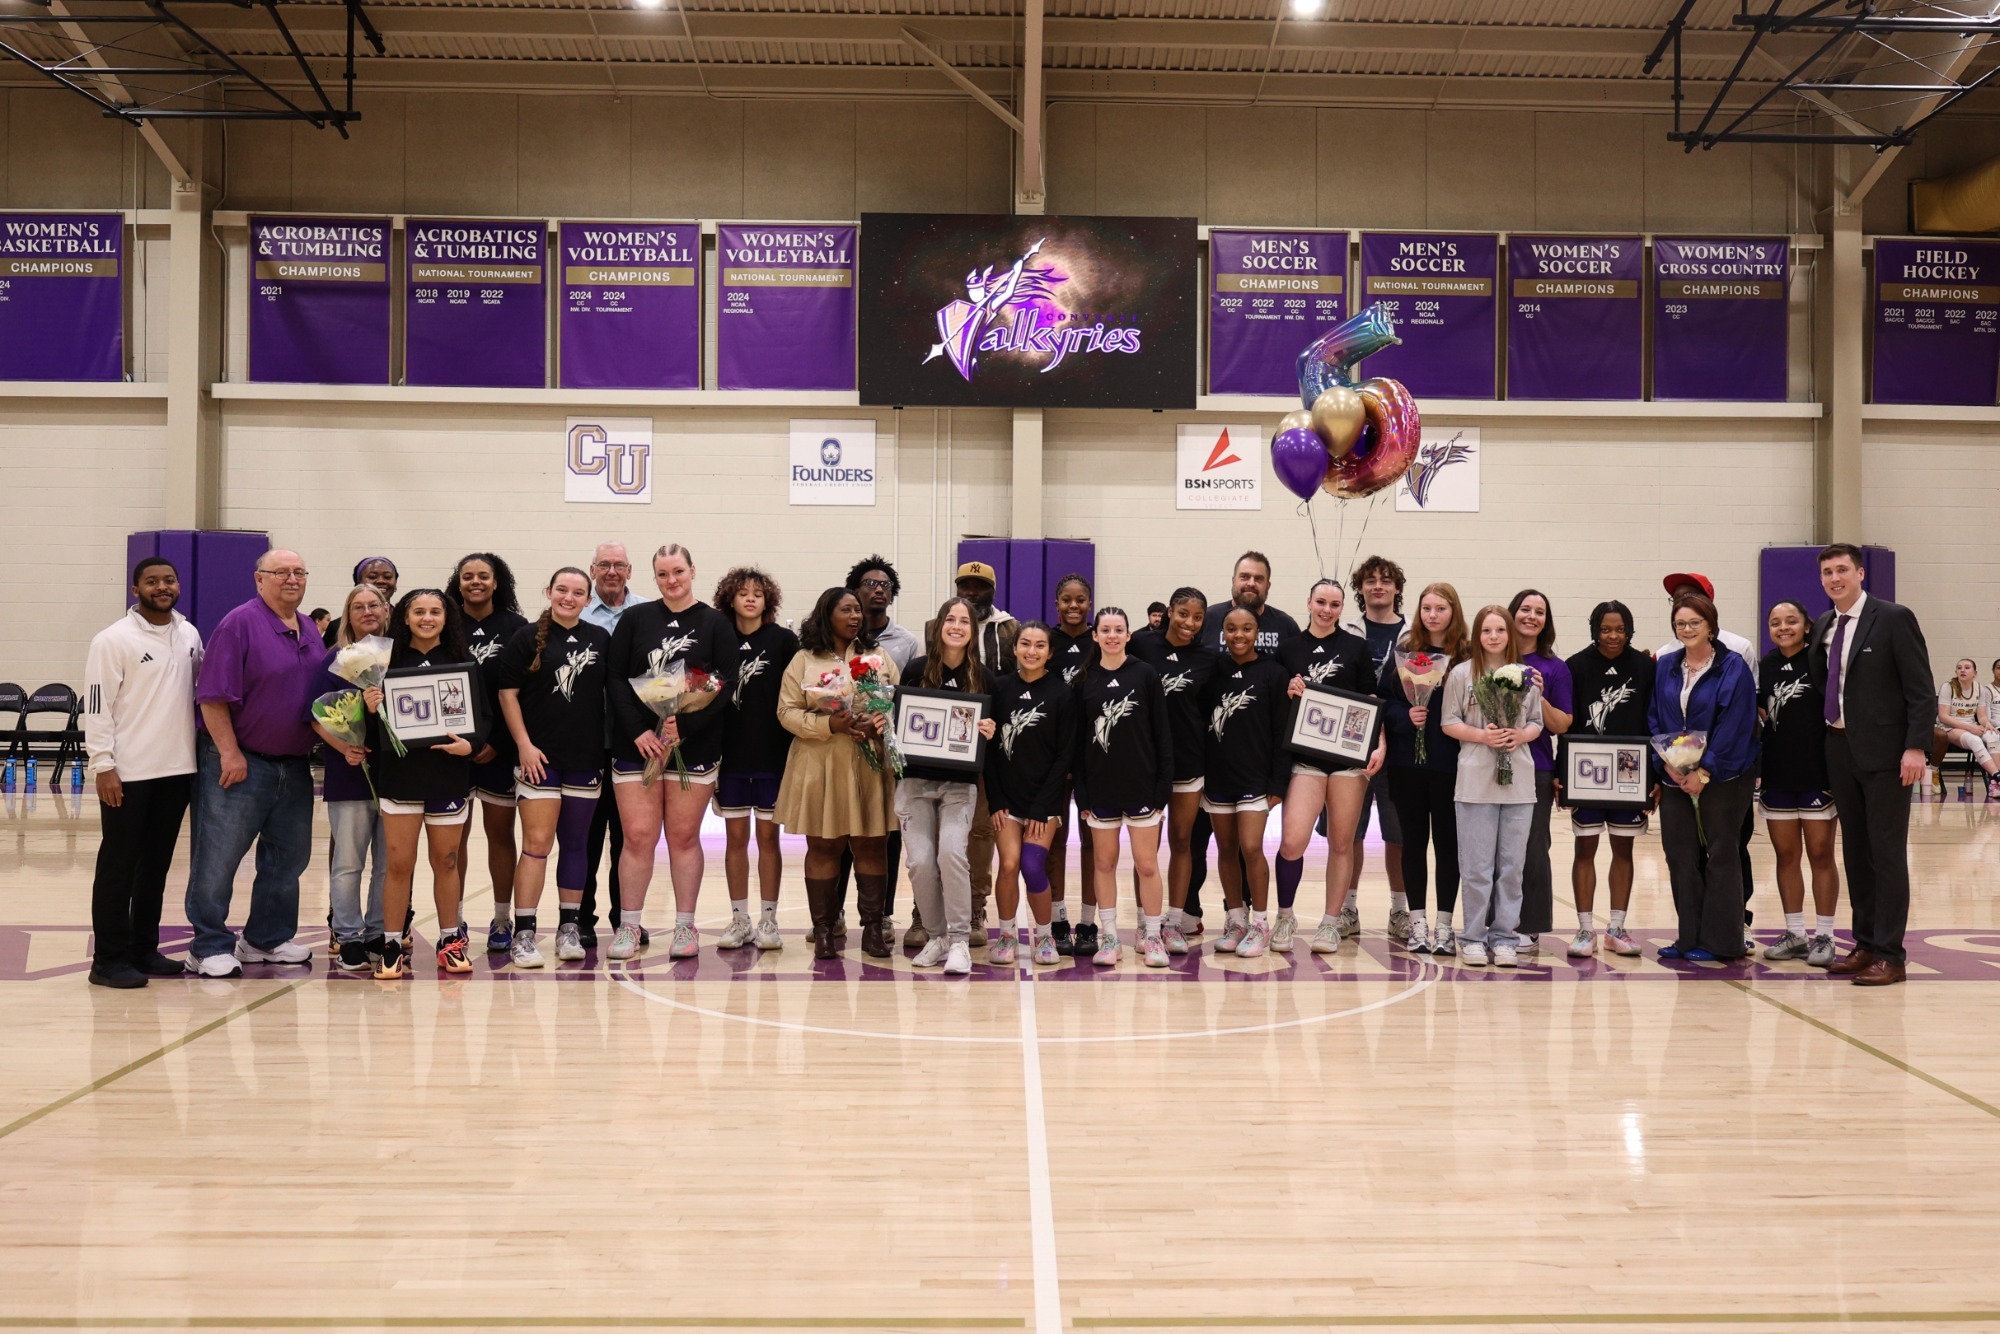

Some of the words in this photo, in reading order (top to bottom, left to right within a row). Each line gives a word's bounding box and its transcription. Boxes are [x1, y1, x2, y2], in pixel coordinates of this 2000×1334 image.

[6, 222, 99, 237] WOMEN'S
[258, 226, 382, 242] ACROBATICS
[414, 228, 538, 244] ACROBATICS
[584, 231, 677, 246] WOMEN'S
[742, 232, 834, 248] WOMEN'S
[0, 238, 116, 252] ASKETBALL
[258, 240, 273, 256] &
[278, 242, 382, 258] TUMBLING
[1251, 239, 1310, 254] MEN'S
[1400, 241, 1457, 256] MEN'S
[414, 244, 429, 258] &
[434, 244, 536, 259] TUMBLING
[568, 248, 693, 262] VOLLEYBALL
[726, 249, 851, 264] VOLLEYBALL
[1531, 244, 1620, 259] WOMEN'S
[1677, 244, 1766, 260] WOMEN'S
[1916, 250, 1968, 264] FIELD
[11, 262, 93, 273] CHAMPIONS
[1242, 256, 1318, 270] SOCCER
[1390, 258, 1466, 272] SOCCER
[1539, 260, 1613, 274] SOCCER
[279, 266, 360, 277] CHAMPIONS
[468, 270, 533, 278] TOURNAMENT
[1659, 264, 1708, 274] CROSS
[1711, 264, 1783, 275] COUNTRY
[1903, 265, 1980, 280] HOCKEY
[589, 271, 670, 282] CHAMPIONS
[779, 274, 844, 282] TOURNAMENT
[0, 280, 10, 288] 24
[1240, 279, 1319, 290] CHAMPIONS
[1374, 282, 1418, 290] NATIONAL
[1422, 283, 1485, 291] TOURNAMENT
[1536, 284, 1615, 294] CHAMPIONS
[260, 286, 282, 295] 2021
[415, 289, 438, 298] 2018
[447, 290, 470, 298] 2019
[480, 290, 503, 298] 2022
[570, 291, 592, 300] 2024
[1682, 285, 1760, 295] CHAMPIONS
[1902, 288, 1979, 300] CHAMPIONS
[603, 292, 626, 300] 2024
[727, 292, 749, 301] 2024
[1220, 298, 1243, 307] 2022
[1252, 299, 1274, 308] 2022
[1284, 300, 1306, 308] 2023
[1316, 300, 1338, 309] 2024
[1415, 302, 1440, 311] 2024
[1518, 304, 1541, 312] 2014
[1665, 305, 1688, 313] 2023
[1884, 308, 1905, 316] 2021
[1915, 309, 1935, 317] 2021
[1945, 310, 1966, 318] 2022
[1975, 311, 1998, 320] 2022
[568, 424, 650, 494] CU
[1184, 479, 1211, 489] BSN
[1213, 479, 1254, 489] SPORTS
[397, 694, 431, 721] CU
[910, 712, 941, 741] CU
[1308, 707, 1336, 736] CU
[1578, 759, 1608, 784] CU
